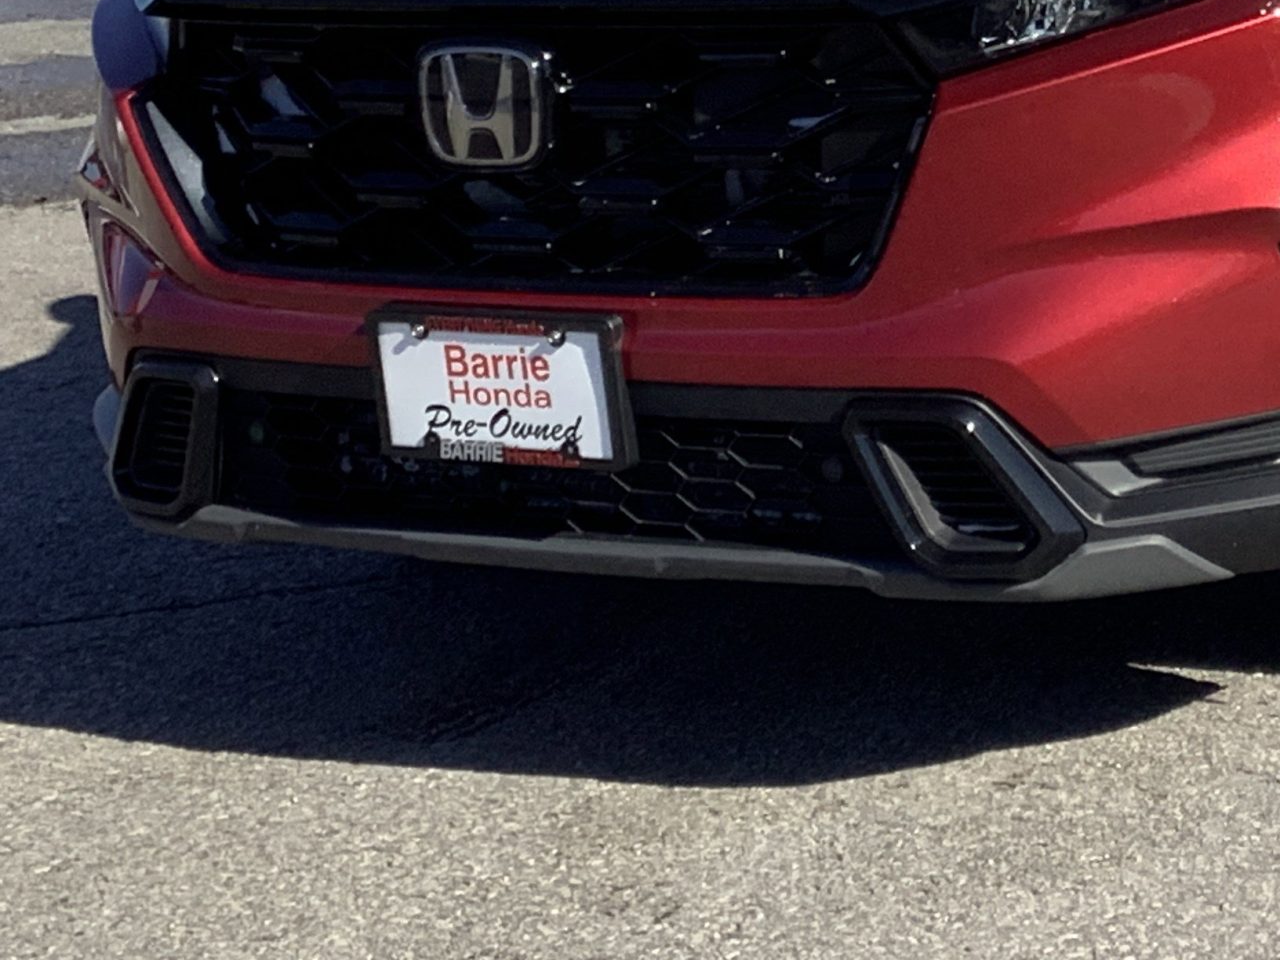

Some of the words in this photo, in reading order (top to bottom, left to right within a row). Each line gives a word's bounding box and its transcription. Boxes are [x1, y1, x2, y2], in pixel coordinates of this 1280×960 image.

[443, 343, 551, 382] Barrie
[448, 379, 553, 409] Honda
[424, 403, 583, 442] Pre-Owned
[439, 438, 504, 463] BARRIE
